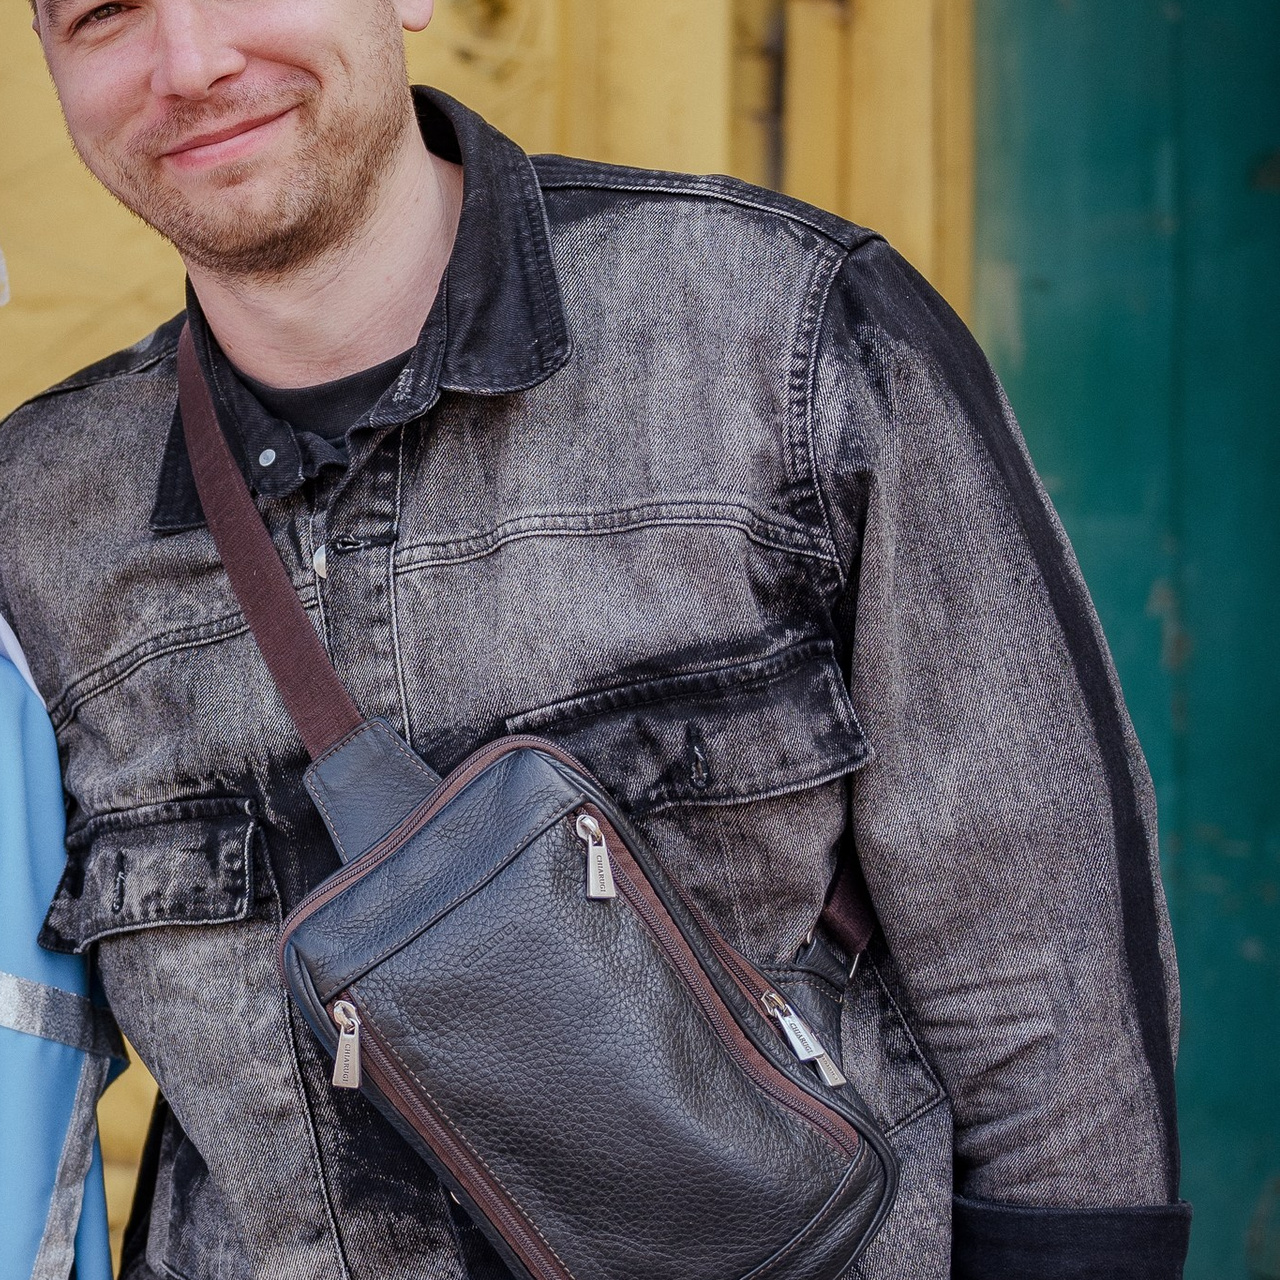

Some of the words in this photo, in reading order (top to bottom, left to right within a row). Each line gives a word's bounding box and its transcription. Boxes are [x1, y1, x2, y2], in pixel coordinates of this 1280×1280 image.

[595, 854, 606, 892] CHIARUGI
[789, 1022, 814, 1054] CHIARUGI
[342, 1043, 352, 1082] CHIARUGI
